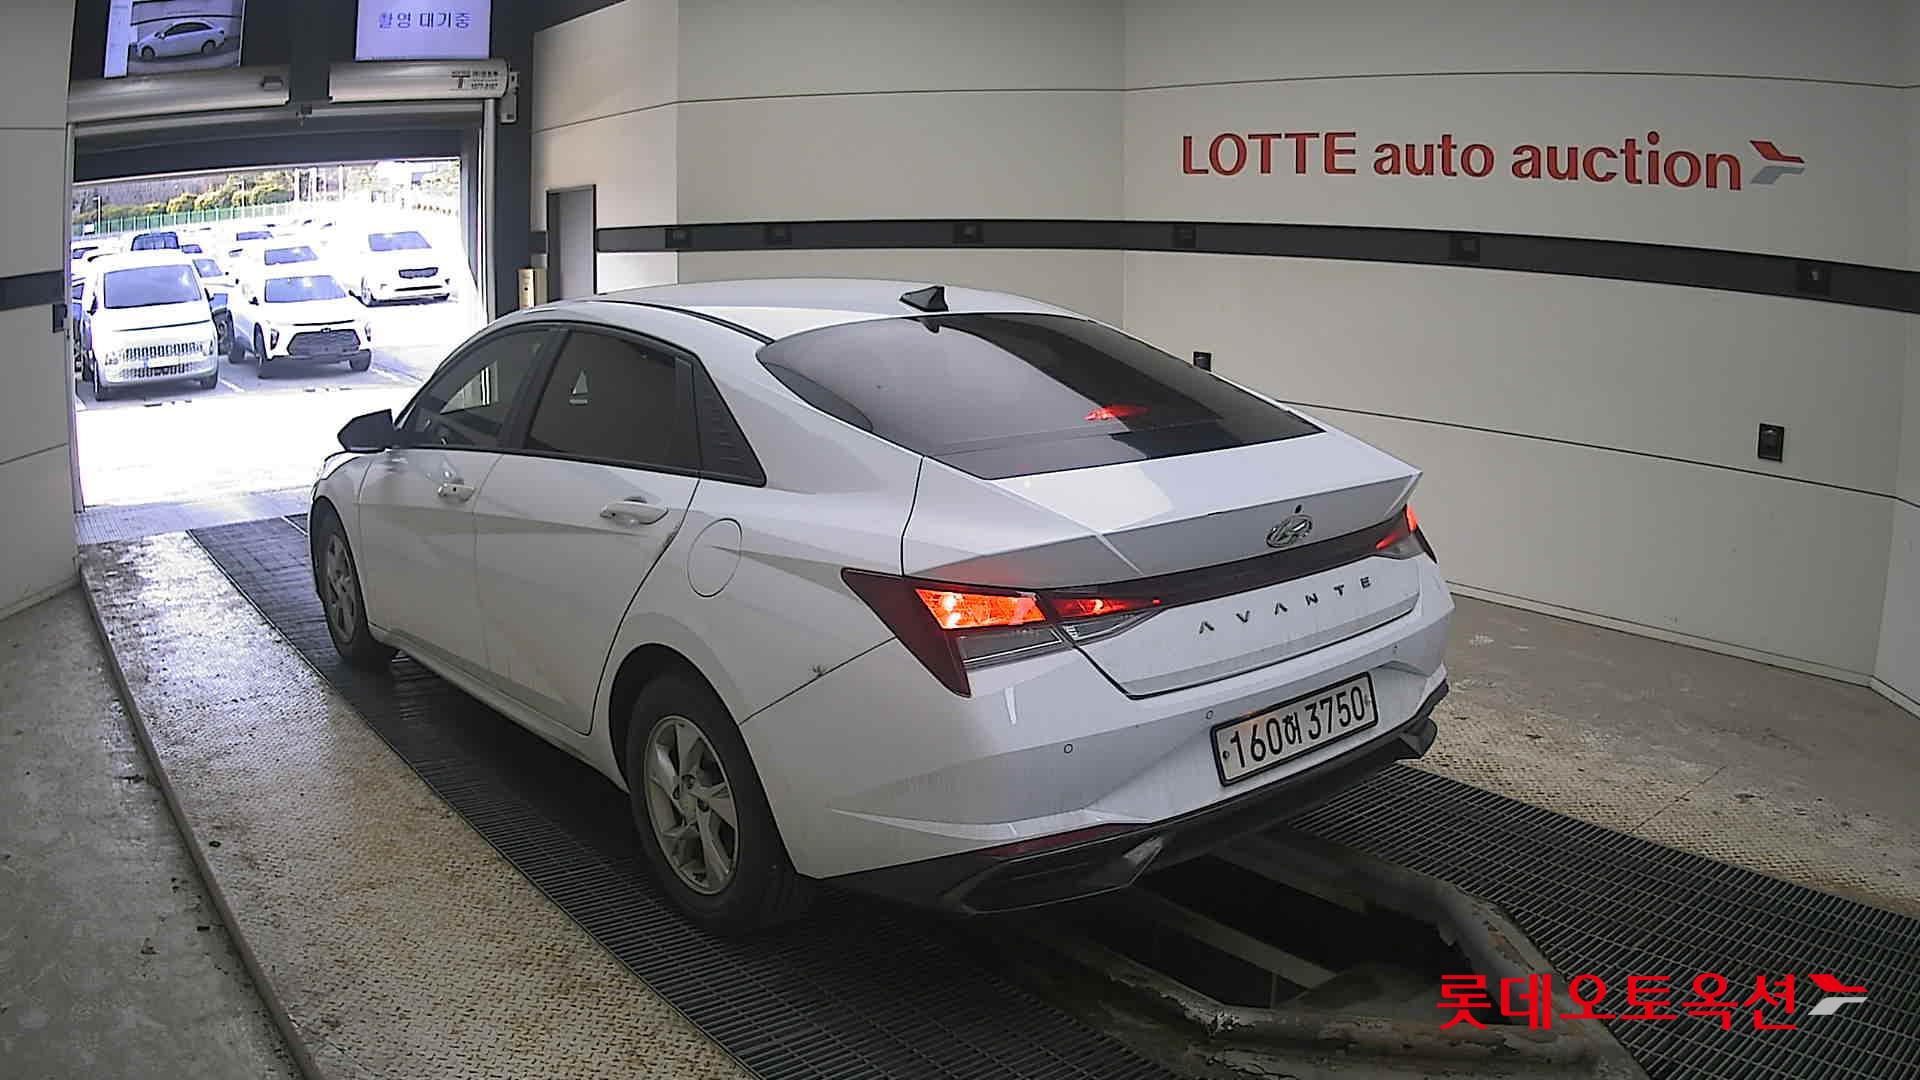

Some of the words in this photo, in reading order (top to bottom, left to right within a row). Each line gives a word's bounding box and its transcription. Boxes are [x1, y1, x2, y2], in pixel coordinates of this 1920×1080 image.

[419, 12, 471, 29] 대기중
[1182, 131, 1357, 177] LOTTE
[1373, 134, 1495, 178] auto
[1511, 131, 1743, 192] auction
[1198, 576, 1372, 635] AVANTE
[1229, 711, 1303, 769] 160허
[1303, 685, 1366, 741] 3750
